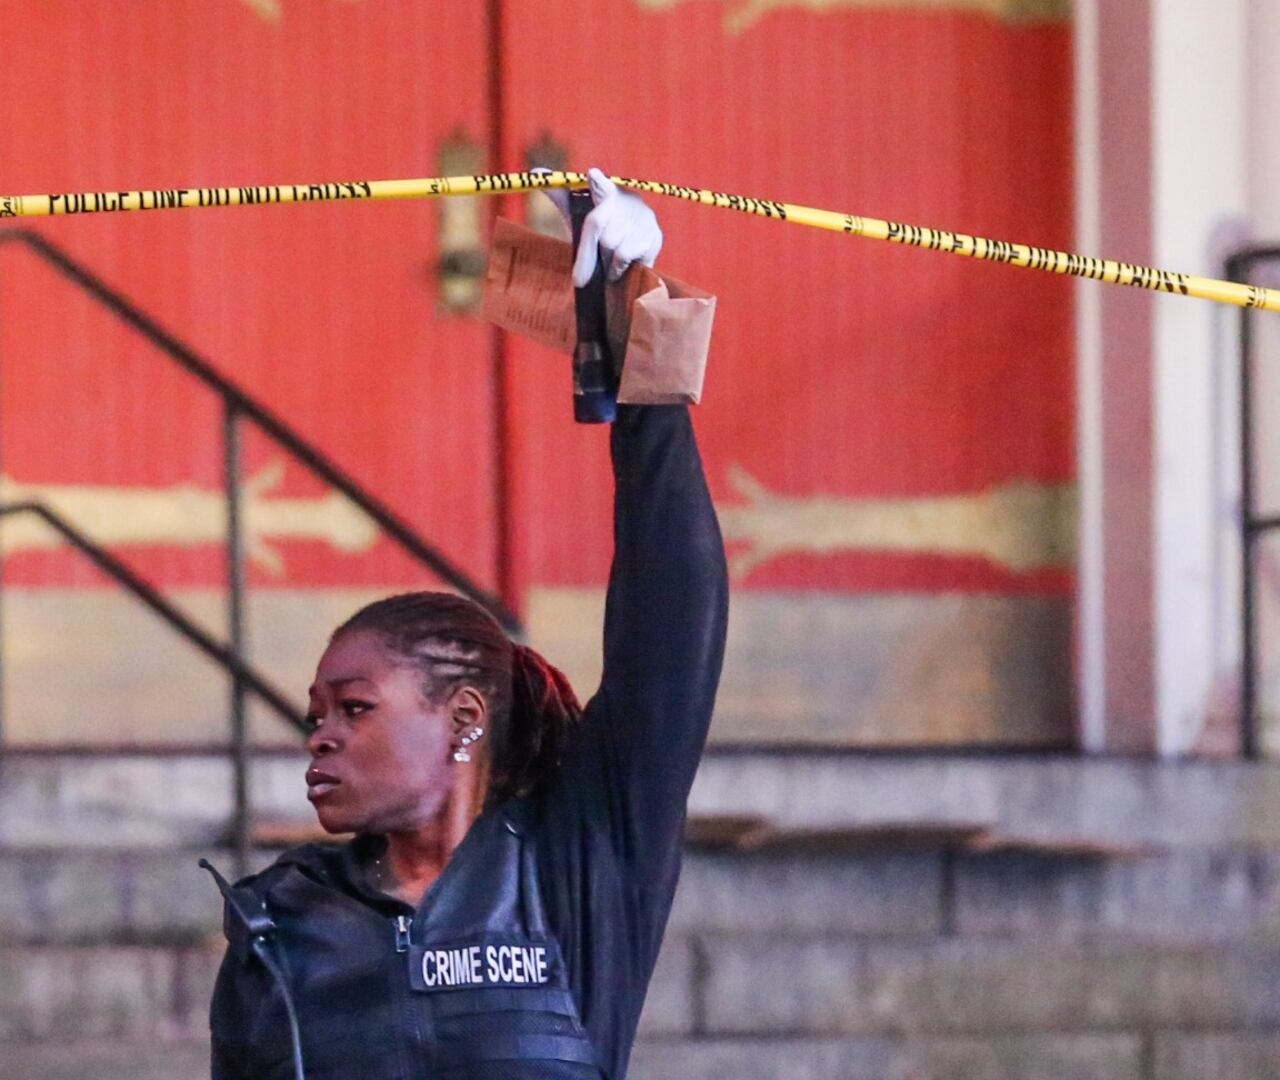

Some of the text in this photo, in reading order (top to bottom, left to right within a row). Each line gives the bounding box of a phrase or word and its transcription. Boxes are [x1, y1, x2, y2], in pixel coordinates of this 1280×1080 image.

[49, 181, 372, 215] POLICE LINE DO NOT CROSS
[422, 945, 549, 986] CRIME SCENE
